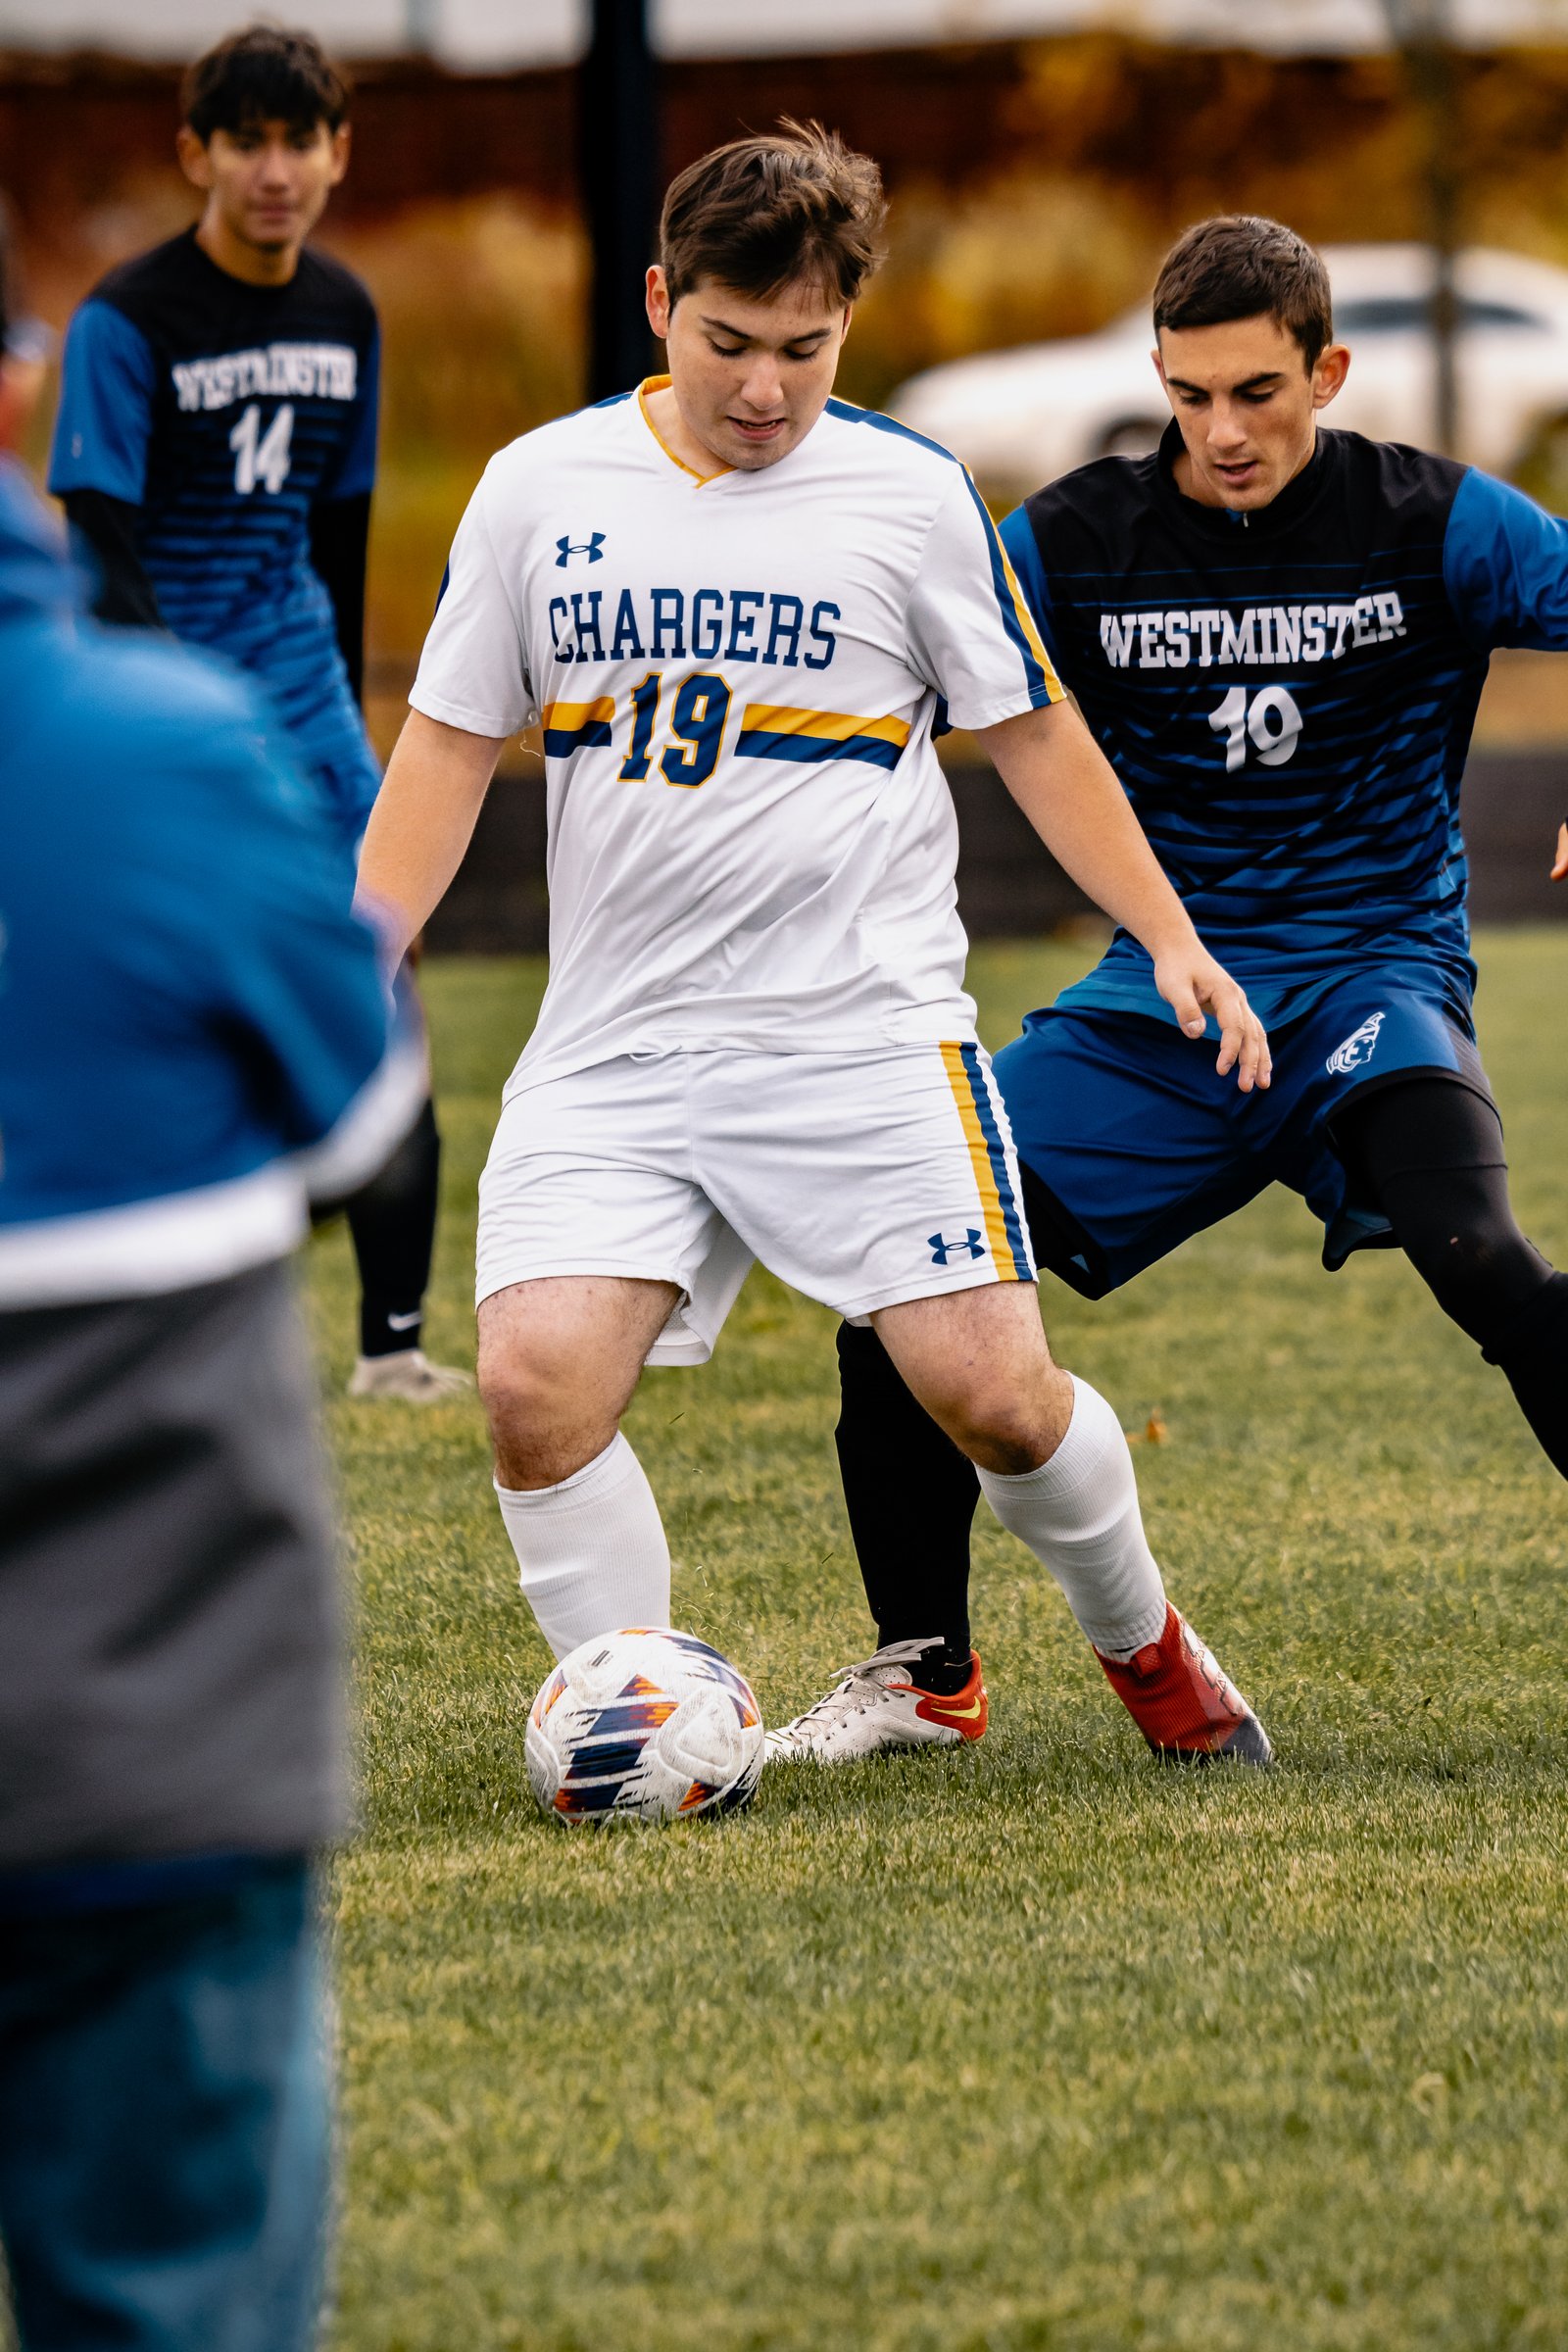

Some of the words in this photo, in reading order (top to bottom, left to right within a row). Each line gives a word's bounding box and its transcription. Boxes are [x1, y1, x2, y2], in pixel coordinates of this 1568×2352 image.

[229, 404, 294, 494] 14
[549, 588, 842, 670] CHARGERS
[1100, 591, 1407, 668] WESTMINSTER
[616, 672, 733, 789] 19
[1207, 686, 1303, 774] 19
